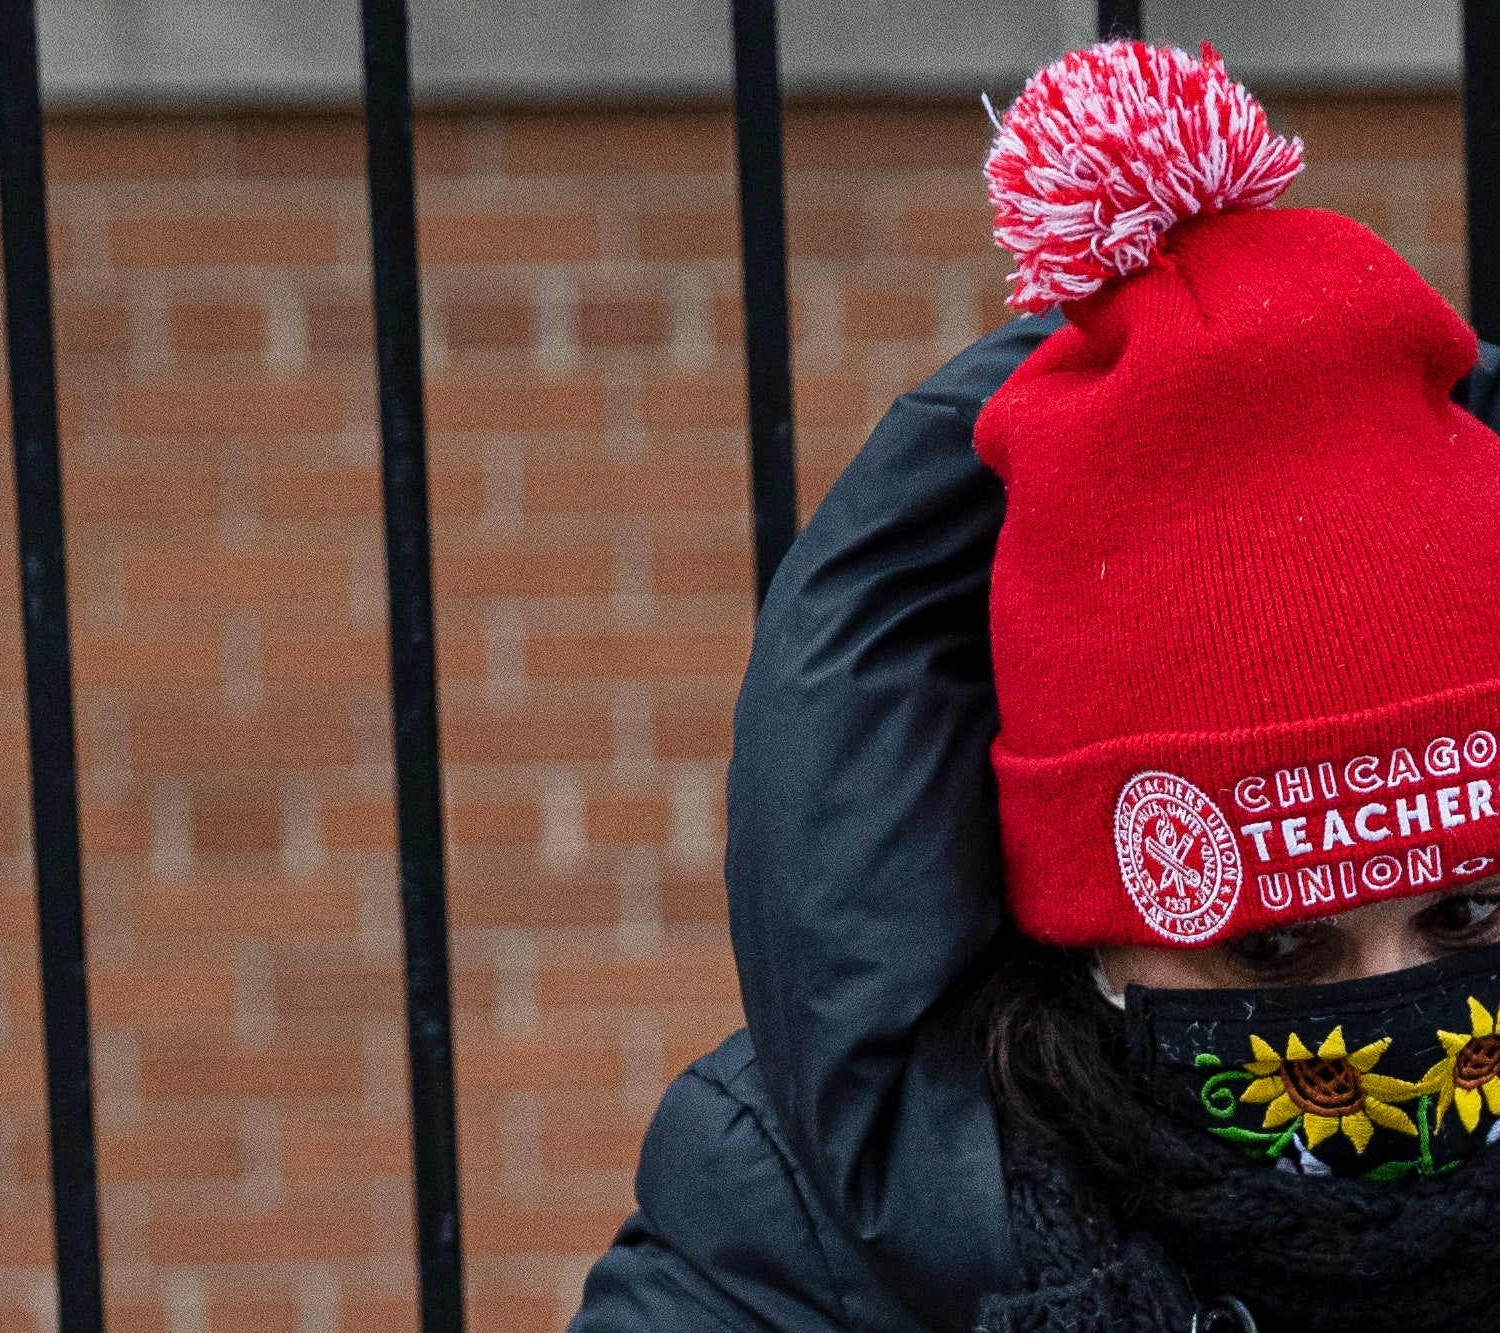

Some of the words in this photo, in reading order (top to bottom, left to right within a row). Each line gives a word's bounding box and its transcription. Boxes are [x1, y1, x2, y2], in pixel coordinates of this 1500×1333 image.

[1129, 778, 1206, 811] TEACHERS
[1235, 730, 1497, 812] CHICAGO
[1119, 801, 1140, 892] CHICAGO
[1206, 813, 1239, 880] UNION
[1257, 844, 1442, 911] UNION
[1176, 908, 1222, 934] LOCAL
